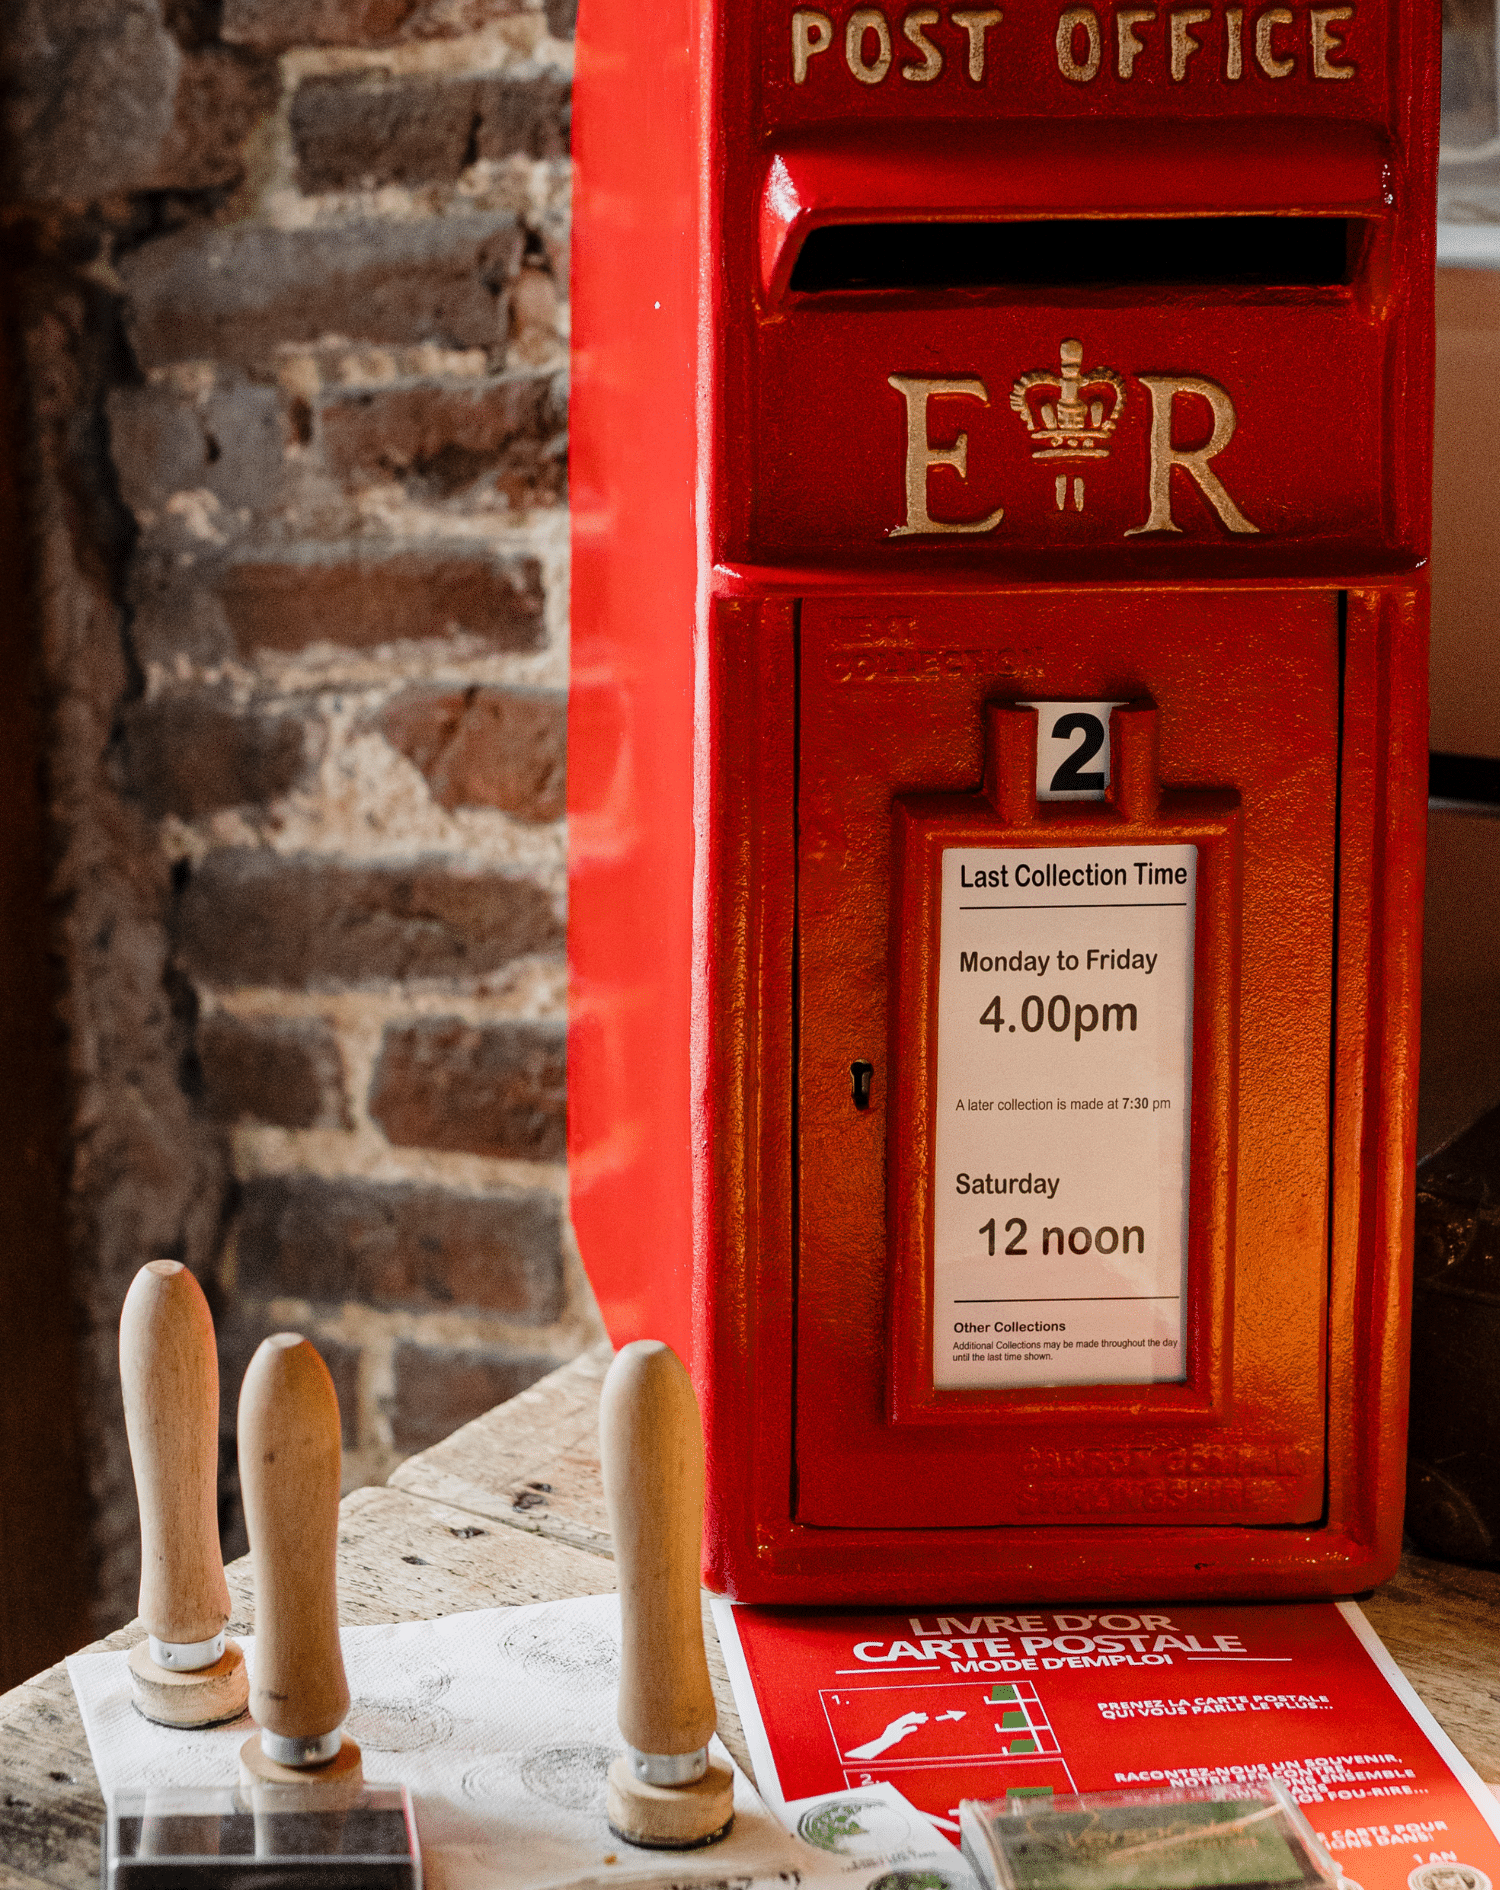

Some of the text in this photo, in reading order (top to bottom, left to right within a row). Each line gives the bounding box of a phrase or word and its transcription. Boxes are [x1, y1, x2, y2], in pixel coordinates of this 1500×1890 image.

[792, 7, 1355, 85] POST OFFICE
[887, 374, 1260, 537] E R
[1050, 713, 1104, 791] 2
[961, 862, 1187, 888] Last Collection Time
[960, 948, 1158, 976] Monday to Friday
[979, 995, 1137, 1042] 4.00pm
[956, 1097, 1170, 1112] A later collection is made at 7:30 pm
[956, 1173, 1060, 1199] Saturday
[979, 1218, 1144, 1256] 12 noon
[954, 1321, 1066, 1333] Other Collections
[953, 1338, 1178, 1350] Additional Collections may be made throughout the day
[953, 1352, 1053, 1361] until the last time shown.
[909, 1614, 1180, 1636] LIVRE D'OR
[853, 1634, 1248, 1662] CARTE POSTALE
[950, 1653, 1174, 1673] MODE D'EMPLOI
[1097, 1700, 1165, 1711] PRENEZ
[1194, 1696, 1249, 1706] CARTE
[1252, 1695, 1330, 1703] POSTALE
[1101, 1701, 1334, 1720] QUI VOUS PARLE LE PLUS...
[1114, 1763, 1268, 1783] RACONTEZ-NOUS
[1271, 1760, 1300, 1772] UN
[1170, 1775, 1232, 1788] NOTRE
[1322, 1769, 1416, 1784] ENSEMBLE
[1331, 1825, 1390, 1840] CARTE
[1394, 1820, 1448, 1835] POUR
